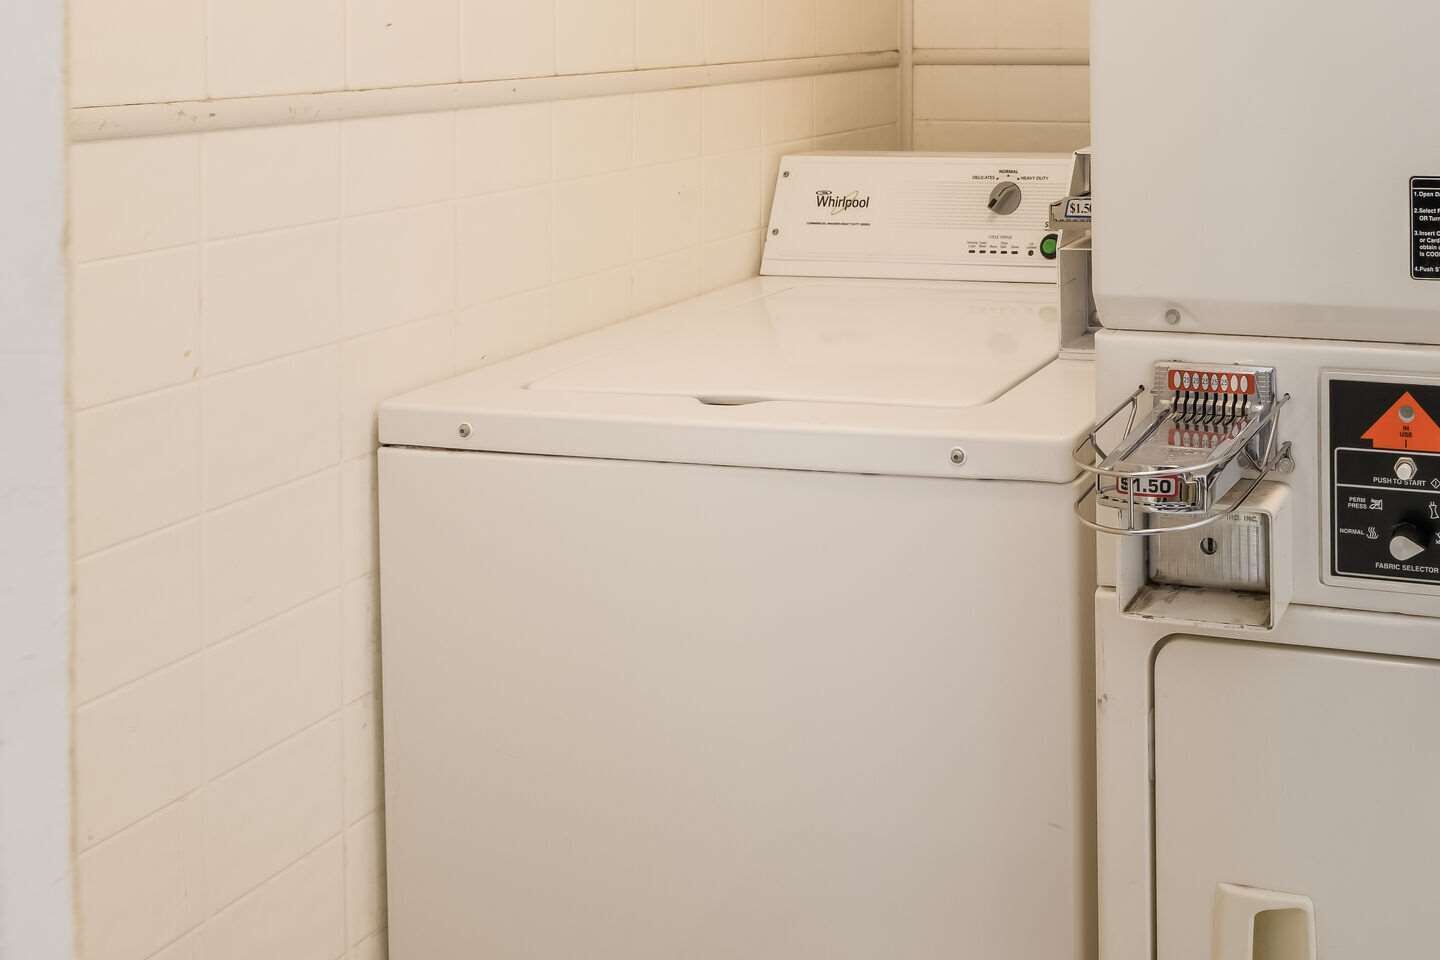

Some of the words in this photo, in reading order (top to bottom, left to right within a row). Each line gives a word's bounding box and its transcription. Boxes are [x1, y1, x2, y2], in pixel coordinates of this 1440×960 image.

[816, 195, 870, 211] Whirlpool
[1373, 476, 1392, 484] PUSH
[1403, 478, 1426, 486] START
[1375, 561, 1400, 570] FABRIC
[1401, 564, 1439, 573] SELECTOR
